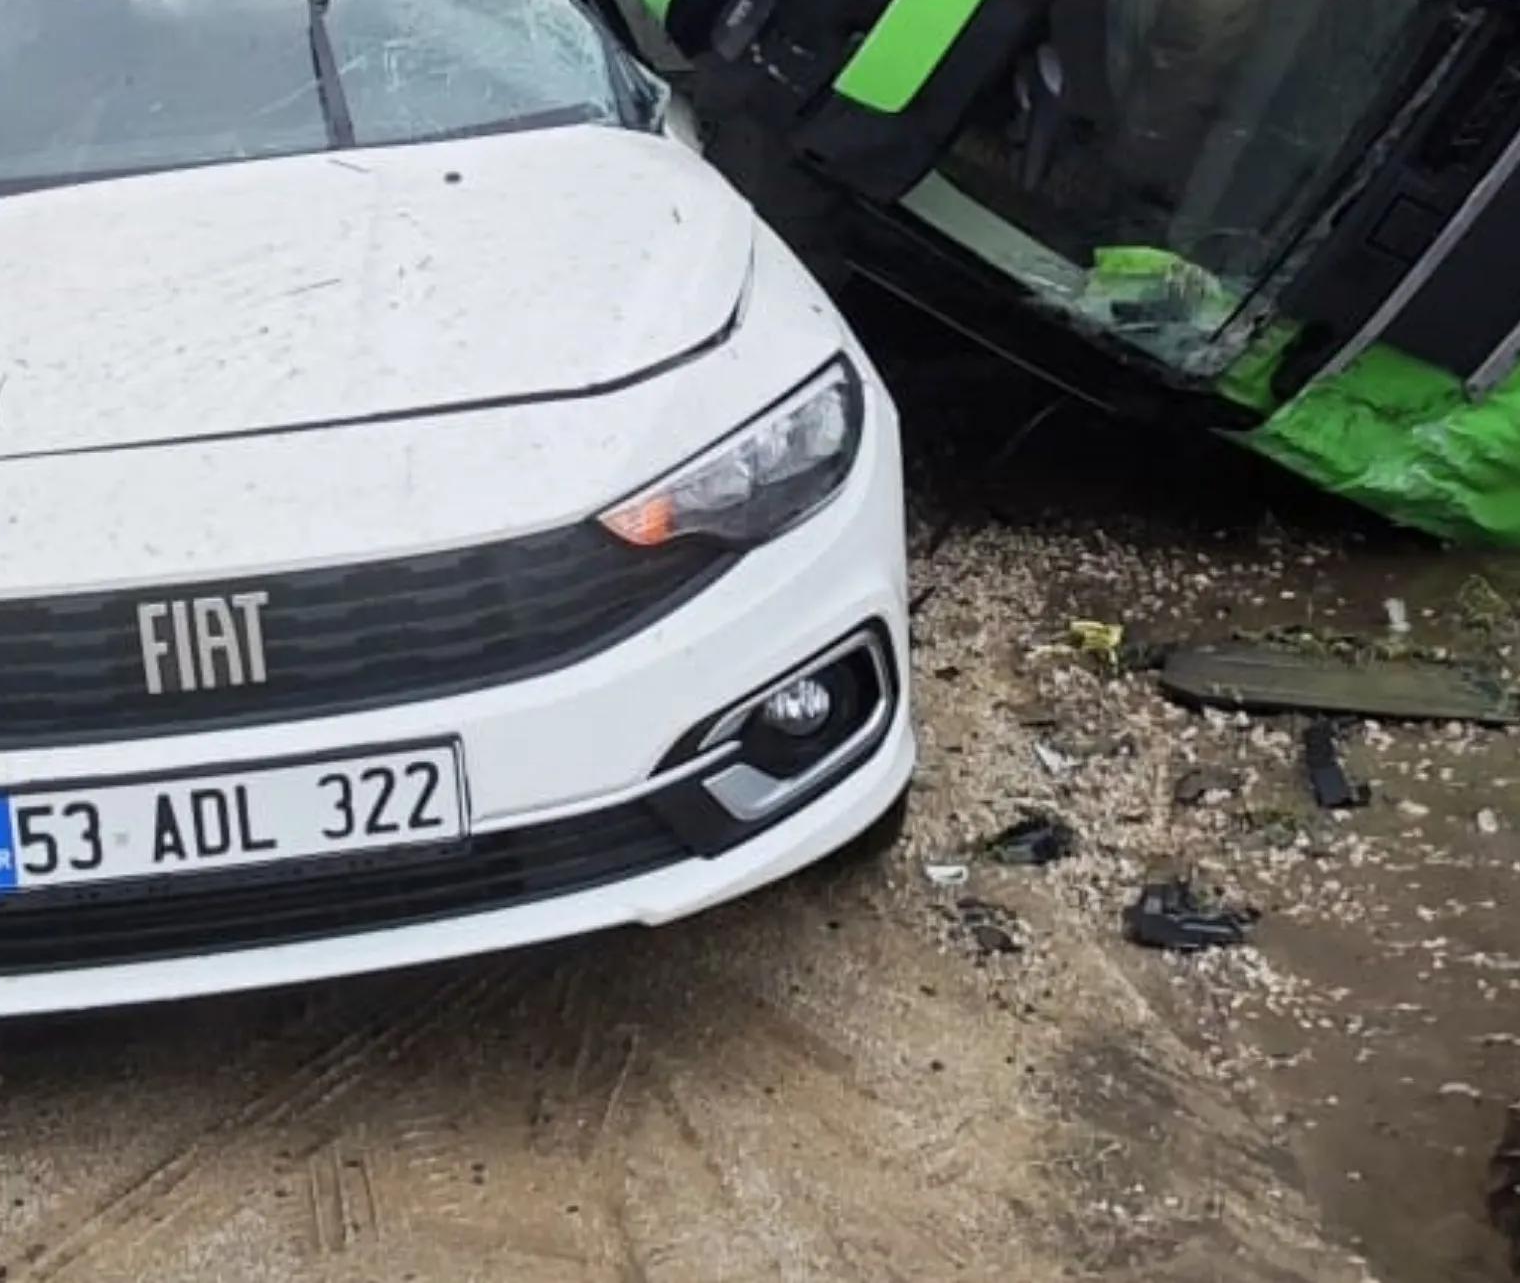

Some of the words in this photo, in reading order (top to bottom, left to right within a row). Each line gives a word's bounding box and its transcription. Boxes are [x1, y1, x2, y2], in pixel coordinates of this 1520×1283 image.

[137, 591, 269, 694] FIAT
[17, 802, 103, 875] 53
[153, 785, 277, 863] ADL
[316, 761, 443, 840] 322
